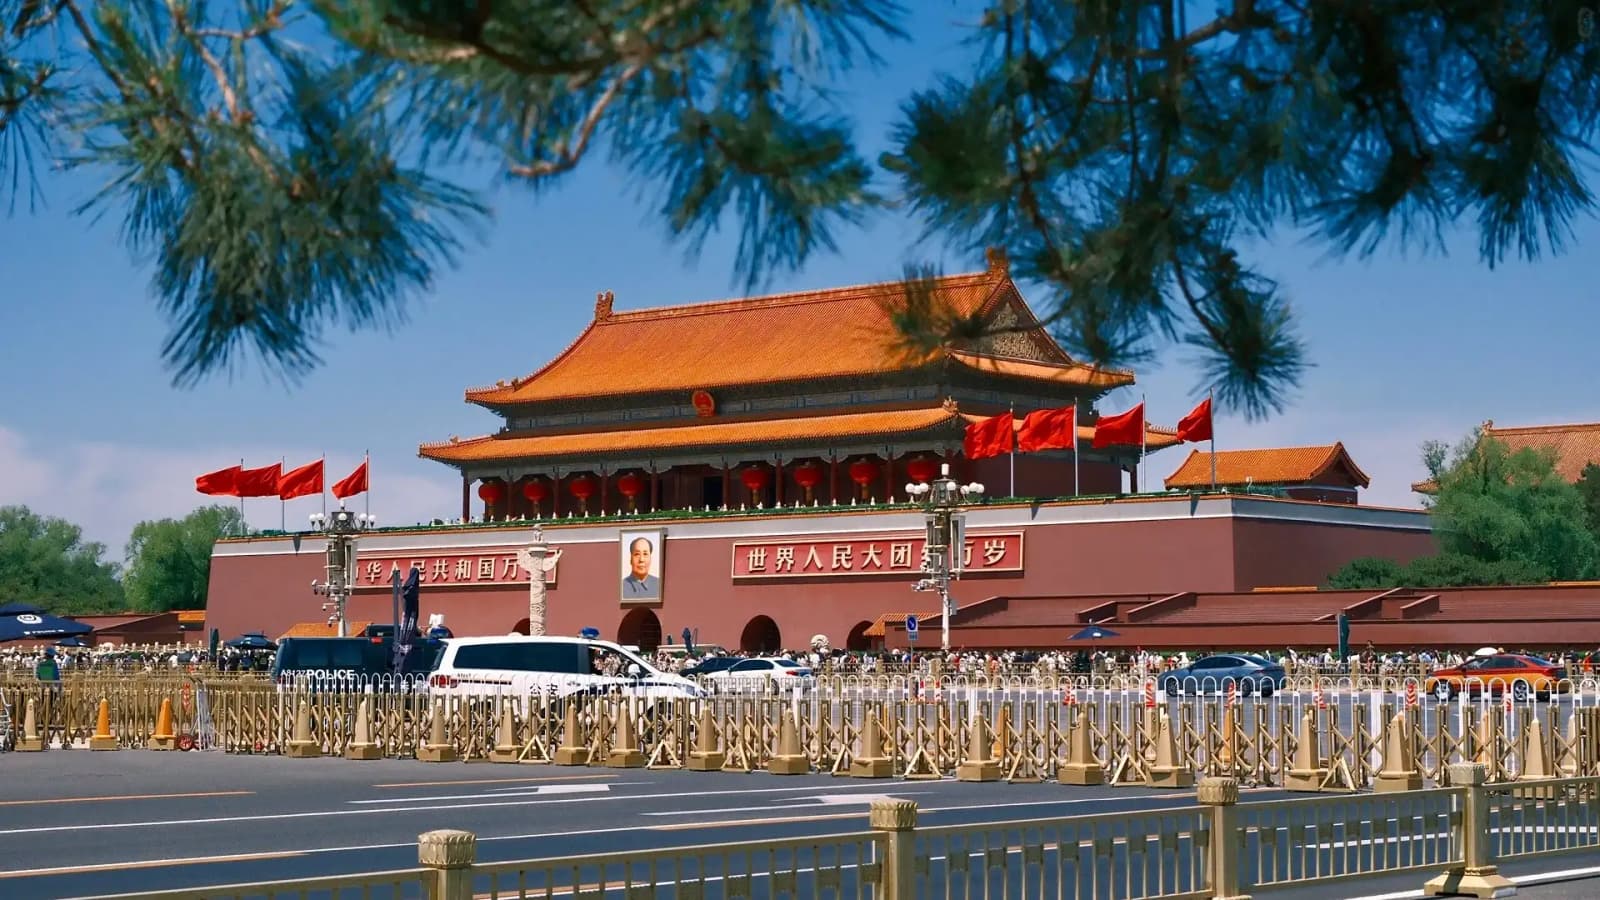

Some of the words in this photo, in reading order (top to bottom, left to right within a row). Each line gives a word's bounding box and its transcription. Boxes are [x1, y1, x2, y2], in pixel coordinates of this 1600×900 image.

[355, 556, 547, 585] 华人民共和国万
[306, 669, 355, 680] POLICE
[529, 683, 558, 696] 公安
